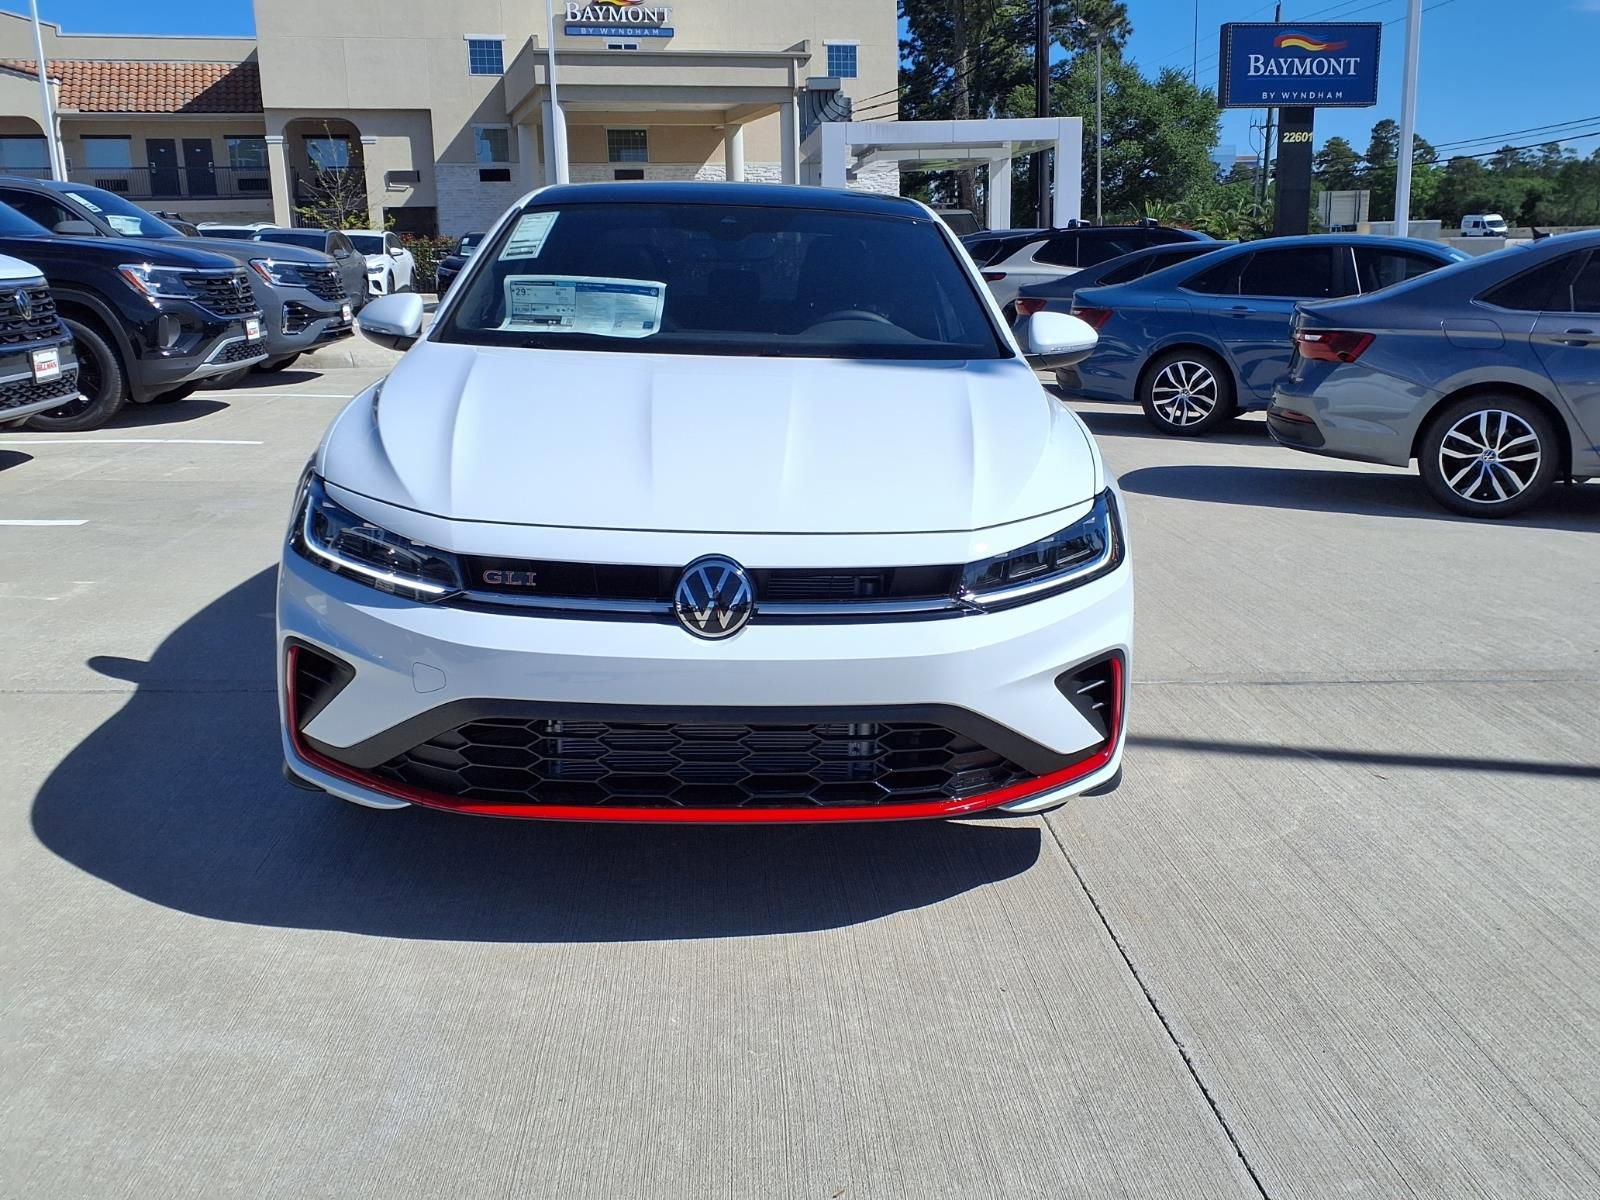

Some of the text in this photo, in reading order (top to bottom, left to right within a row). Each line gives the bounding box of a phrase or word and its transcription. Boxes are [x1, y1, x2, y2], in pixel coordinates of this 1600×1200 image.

[565, 2, 672, 22] BAYMONT
[600, 28, 660, 36] WYNDHAM
[1247, 54, 1360, 76] BAYMONT
[1262, 91, 1343, 100] BY WYNDHAM
[1282, 131, 1313, 143] 22601
[515, 287, 526, 296] 29
[482, 570, 537, 586] GLI
